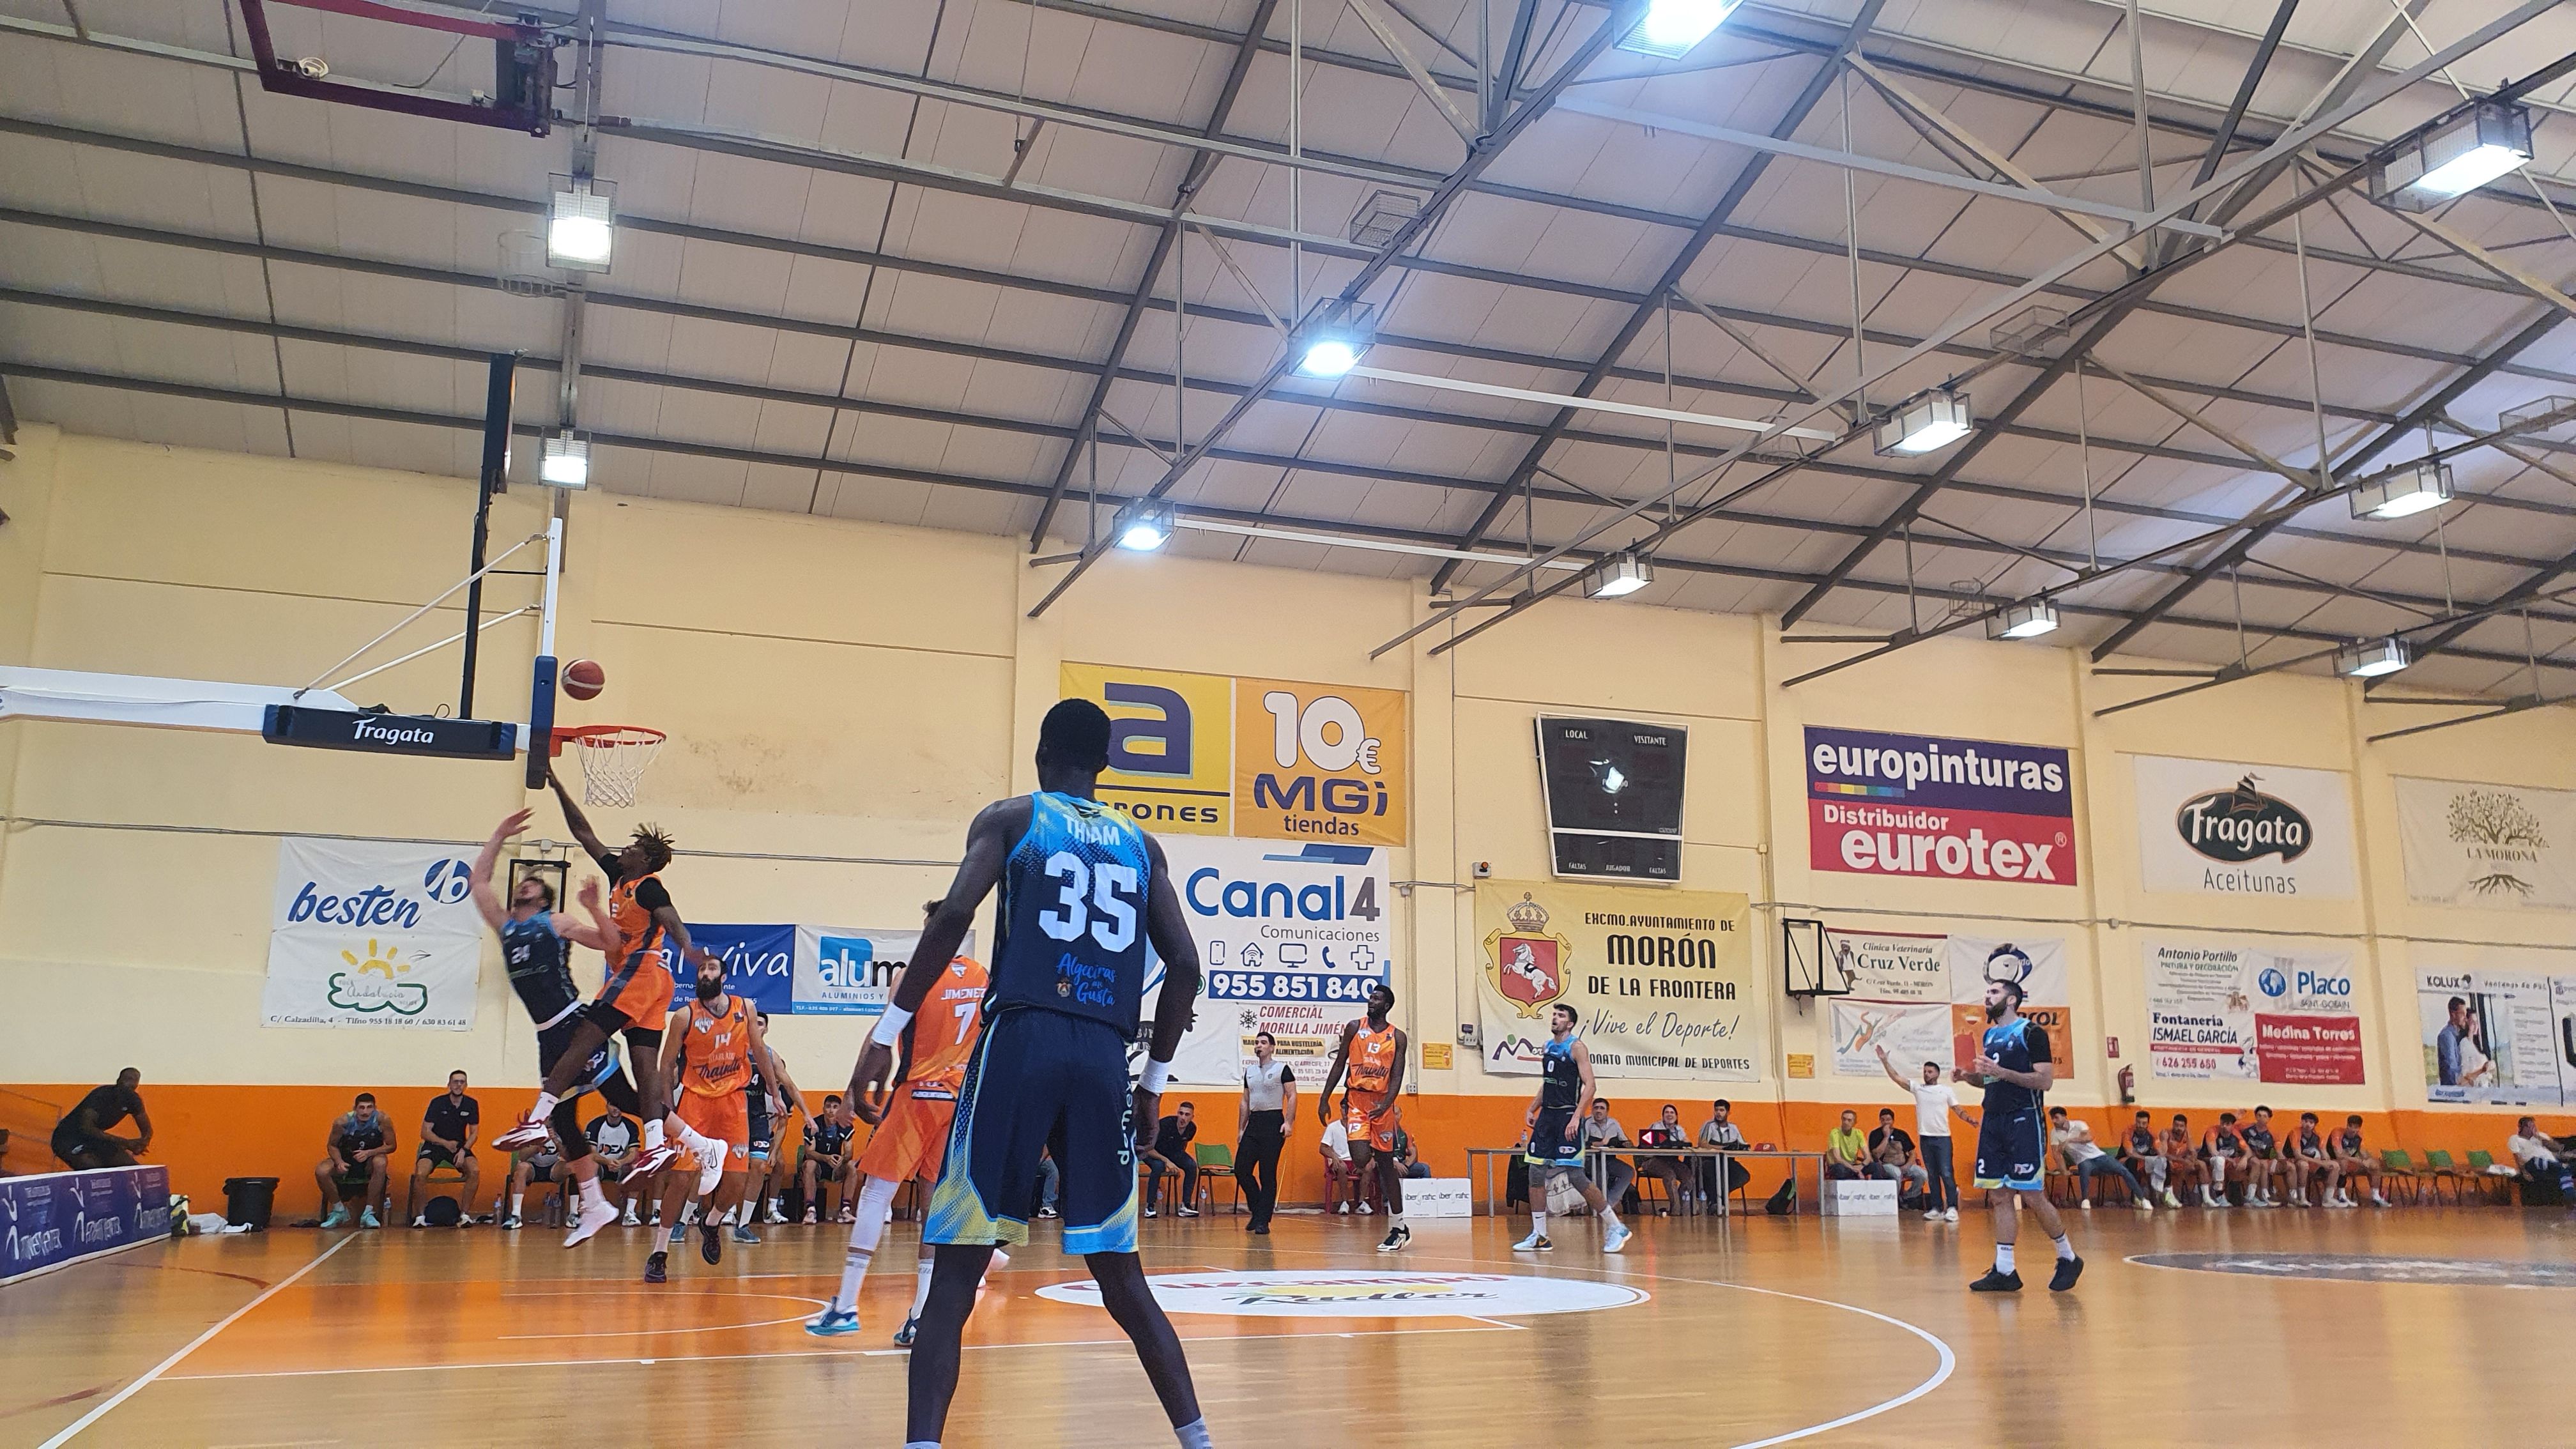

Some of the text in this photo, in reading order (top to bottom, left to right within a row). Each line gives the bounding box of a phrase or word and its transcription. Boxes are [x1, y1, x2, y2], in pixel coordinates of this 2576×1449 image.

[352, 716, 434, 746] Fragata
[1263, 690, 1381, 774] 10€
[1565, 730, 1667, 746] LOCAL VISITANTE
[1813, 743, 2064, 793] europinturas
[1284, 814, 1360, 836] tiendas
[1824, 804, 1949, 831] Distribuidor
[2184, 797, 2303, 852] Fragata
[1064, 814, 1121, 846] THIAM
[2204, 867, 2296, 894] Aceitunas
[288, 881, 422, 928] besten
[1039, 850, 1138, 953] 35
[1261, 924, 1380, 942] Comunicaciones
[1721, 919, 1735, 931] DE
[1607, 932, 1717, 969] MORÓN
[2158, 947, 2237, 963] Antonio Portillo
[1857, 953, 1940, 972] Cruz Verde
[1213, 973, 1378, 1000] 955 851 840
[1588, 976, 1736, 1000] DE LA FRONTERA
[2298, 970, 2351, 995] Placo
[822, 992, 875, 1000] ALUMINIOS
[1259, 1006, 1323, 1018] COMERCIAL
[954, 1002, 977, 1045] 7
[1259, 1022, 1308, 1034] MORILLA
[1636, 1011, 1657, 1035] el
[1662, 1011, 1740, 1047] Deporte!
[2312, 1026, 2355, 1041] Torres
[715, 1032, 732, 1049] 14
[2153, 1027, 2237, 1043] ISMAEL GARCÍA
[1367, 1042, 1381, 1054] 13
[1547, 1061, 1554, 1073] 0
[1590, 1053, 1750, 1070] ONATO MUNICIPAL DE DEPORTES
[1348, 1123, 1361, 1133] 13
[1978, 1158, 1986, 1174] 2
